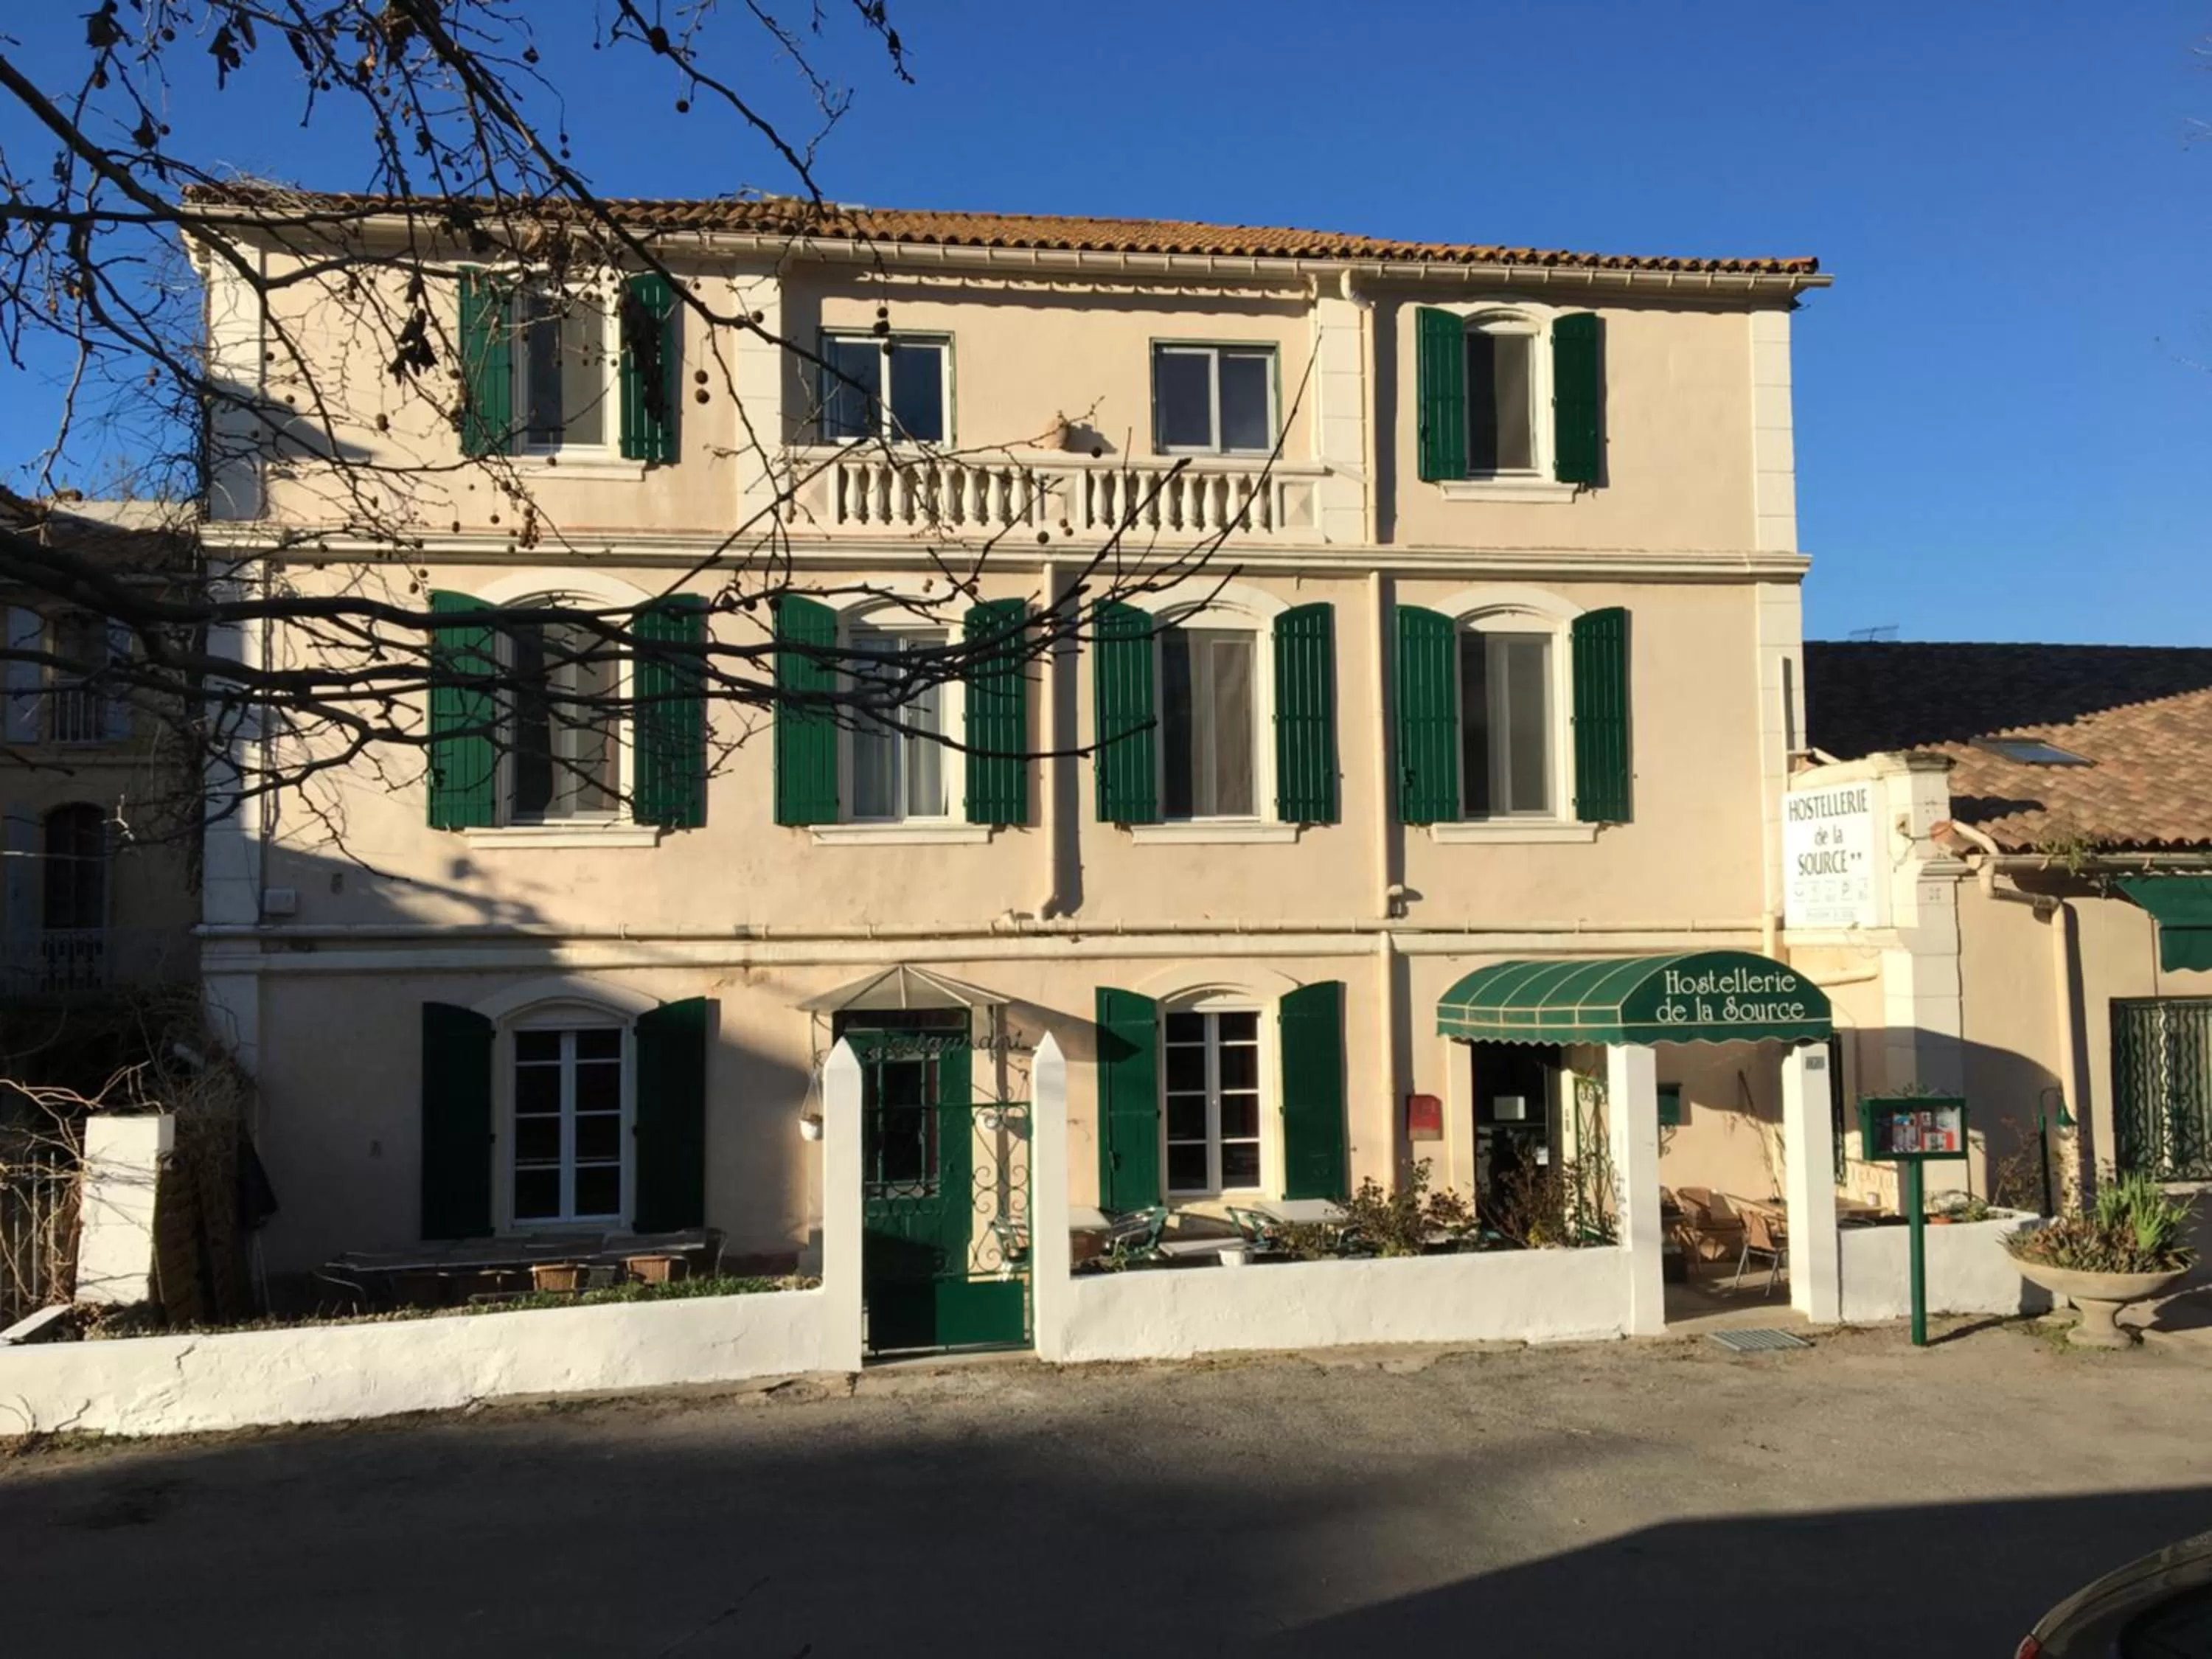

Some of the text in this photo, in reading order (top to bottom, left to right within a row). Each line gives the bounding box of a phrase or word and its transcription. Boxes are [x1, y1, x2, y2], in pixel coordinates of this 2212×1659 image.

[1789, 789, 1868, 822] HOSTELLERIE
[1814, 824, 1843, 846] de la
[1798, 850, 1848, 876] SOURCE
[1664, 967, 1797, 995] Hostellerie
[1656, 996, 1806, 1023] de la Source
